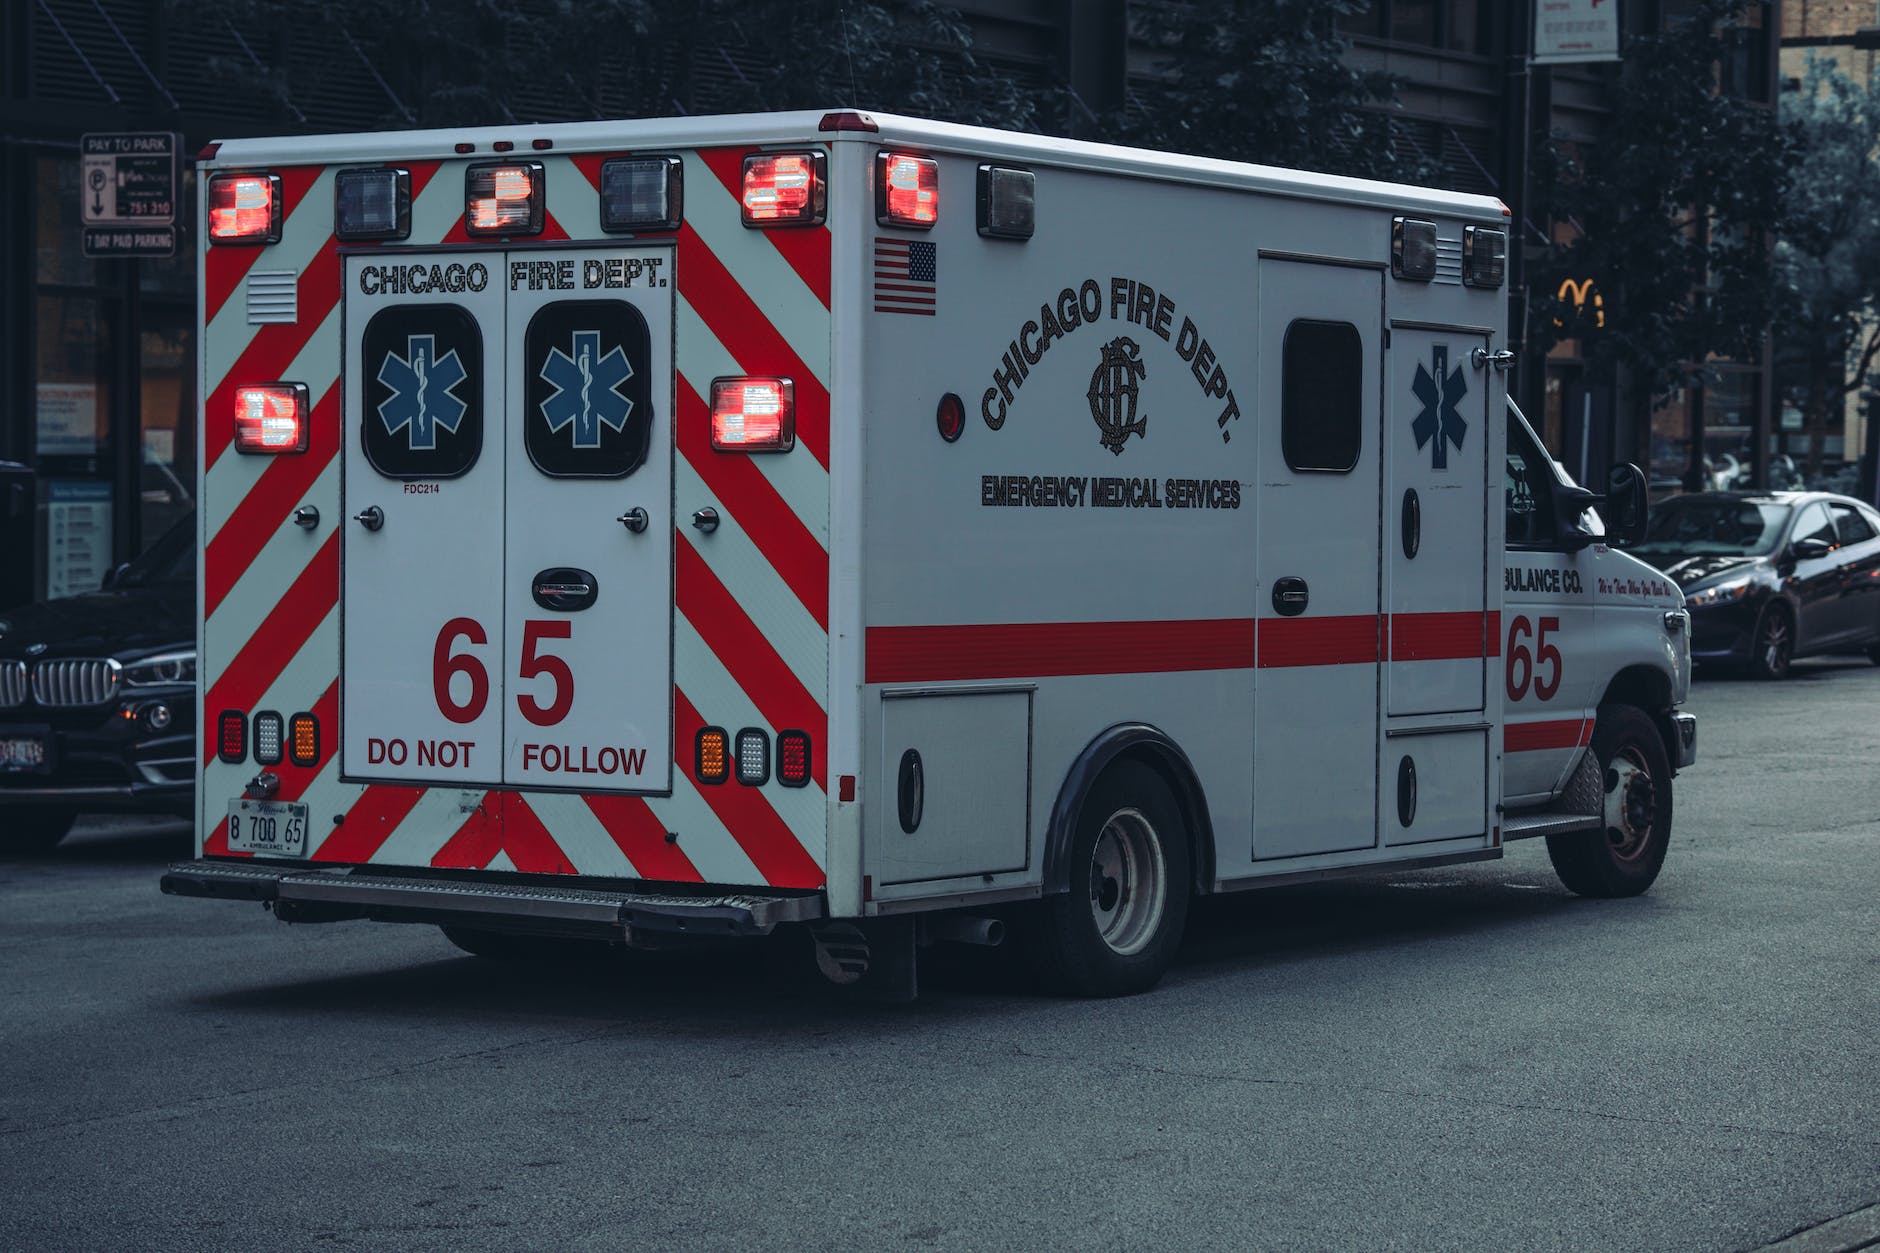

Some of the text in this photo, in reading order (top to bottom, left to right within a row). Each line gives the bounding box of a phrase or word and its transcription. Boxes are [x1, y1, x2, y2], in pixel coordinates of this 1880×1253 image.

[88, 138, 166, 152] PAY TO PARK
[94, 234, 110, 248] DAY
[112, 234, 134, 248] PAID
[134, 234, 172, 248] PARKING
[360, 262, 488, 295] CHICAGO
[510, 258, 667, 291] FIRE DEPT.
[981, 277, 1241, 444] CHICAGO FIRE DEPT.
[404, 483, 440, 494] FDC214
[981, 475, 1241, 509] EMERGENCY MEDICAL SERVICES
[1562, 569, 1583, 594] CO.
[433, 617, 575, 727] 65
[1506, 614, 1562, 702] 65
[368, 738, 475, 768] DO NOT
[522, 744, 647, 775] FOLLOW
[231, 815, 302, 843] 8 700 65
[249, 842, 284, 850] AMBULANCE
